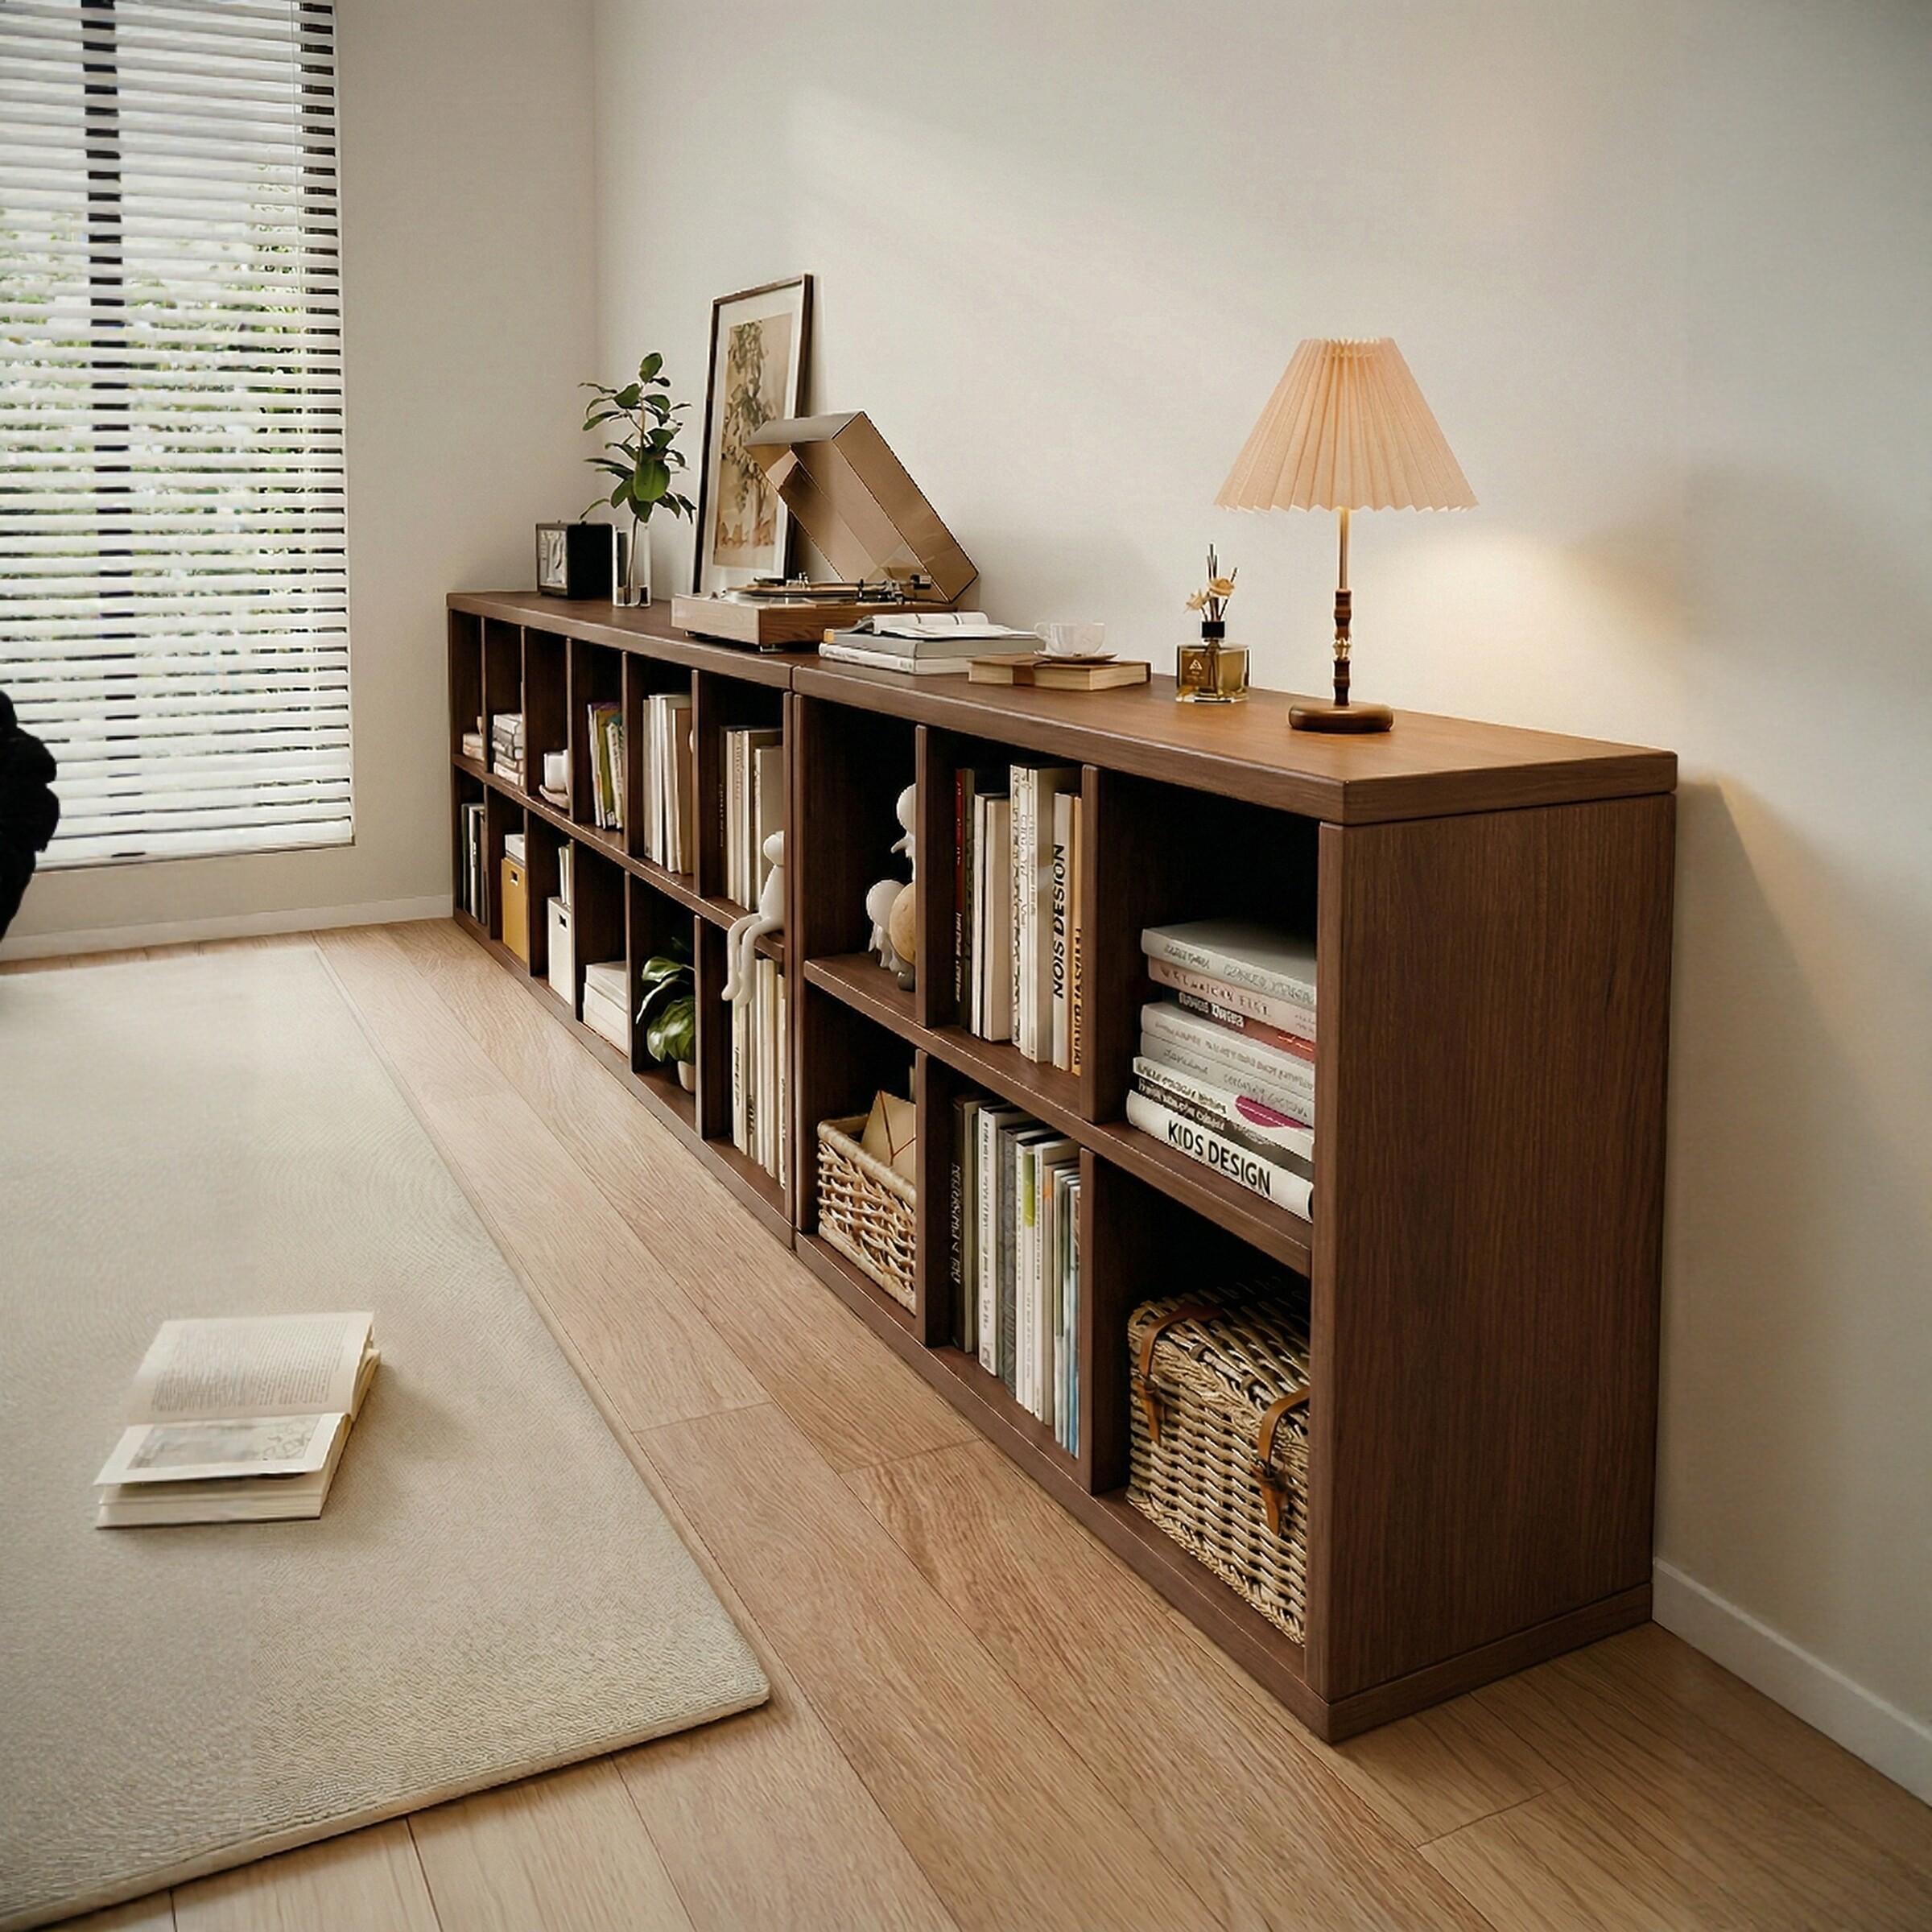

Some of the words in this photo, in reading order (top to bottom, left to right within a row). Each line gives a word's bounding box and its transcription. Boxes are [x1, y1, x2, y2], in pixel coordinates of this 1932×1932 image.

[1053, 940, 1065, 999] NOIS
[1168, 1120, 1204, 1157] KIDS
[1208, 1140, 1271, 1196] DESIGN
